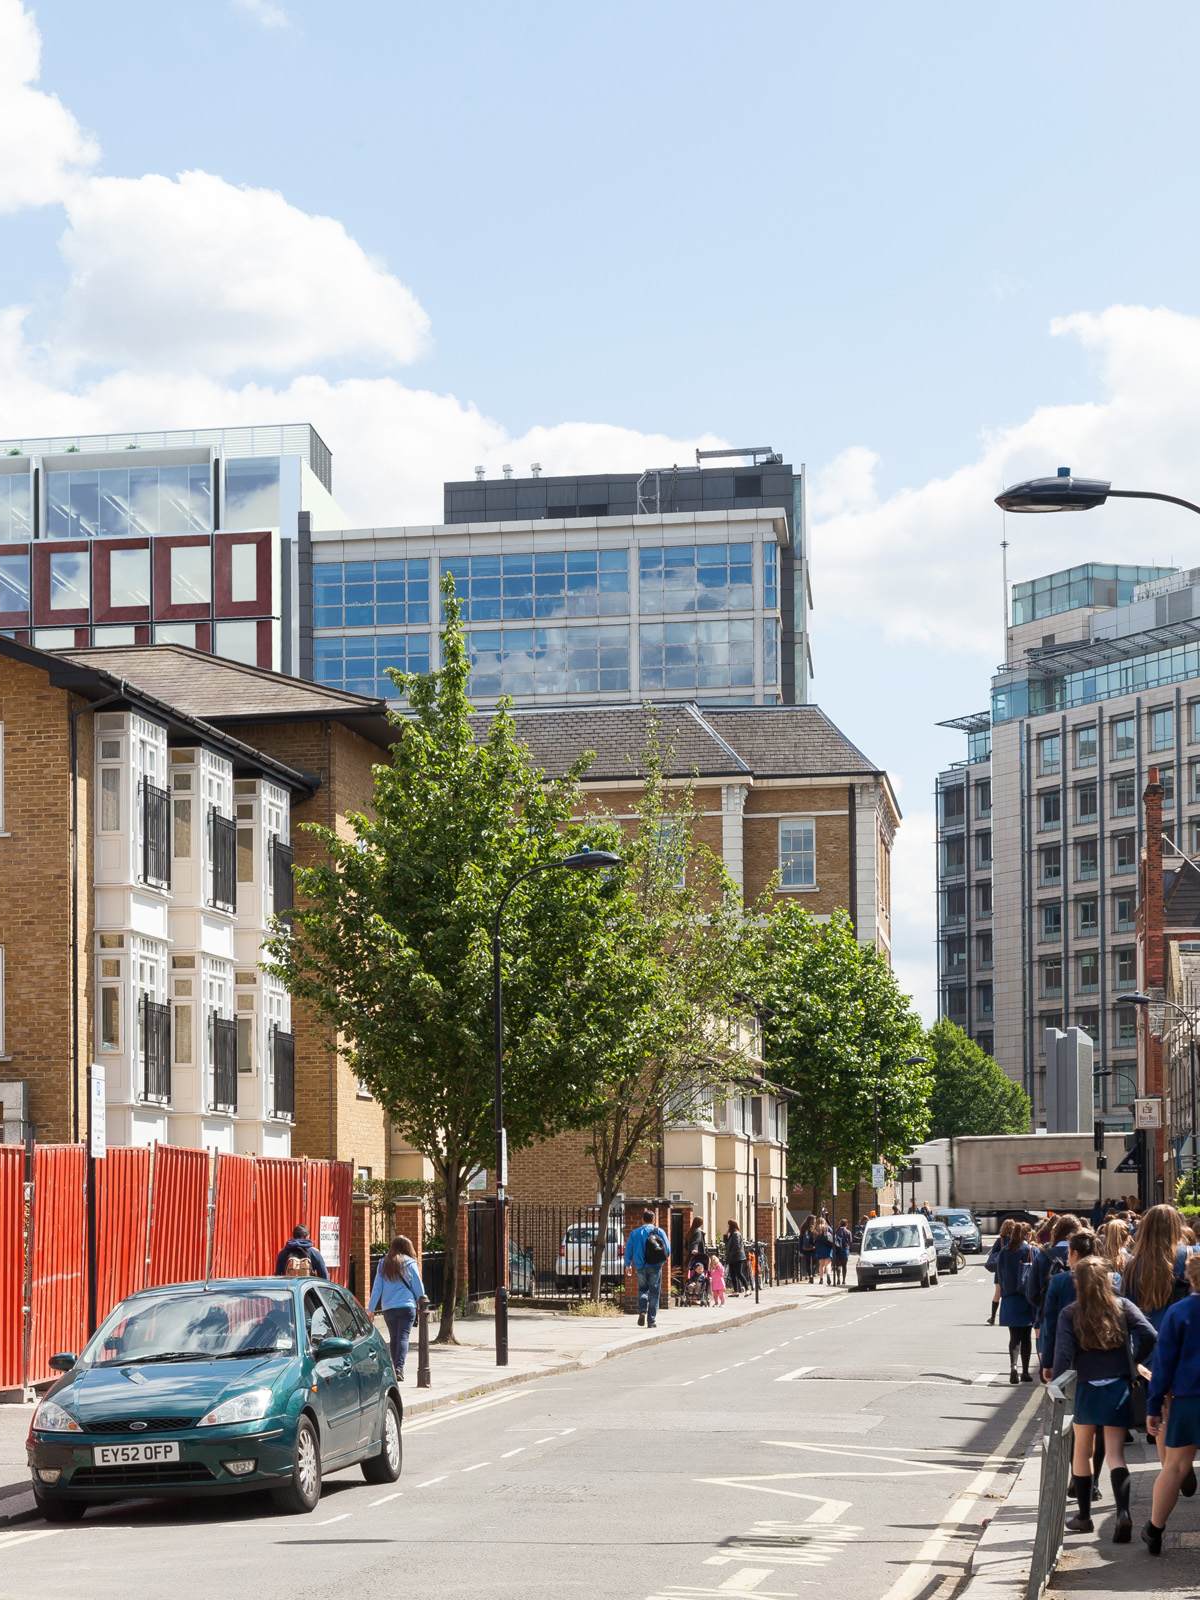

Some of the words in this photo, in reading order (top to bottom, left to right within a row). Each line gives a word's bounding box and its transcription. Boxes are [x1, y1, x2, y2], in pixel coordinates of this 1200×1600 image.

[101, 1447, 140, 1463] EY52
[144, 1445, 173, 1460] OFP
[702, 1520, 865, 1566] SCHOOL
